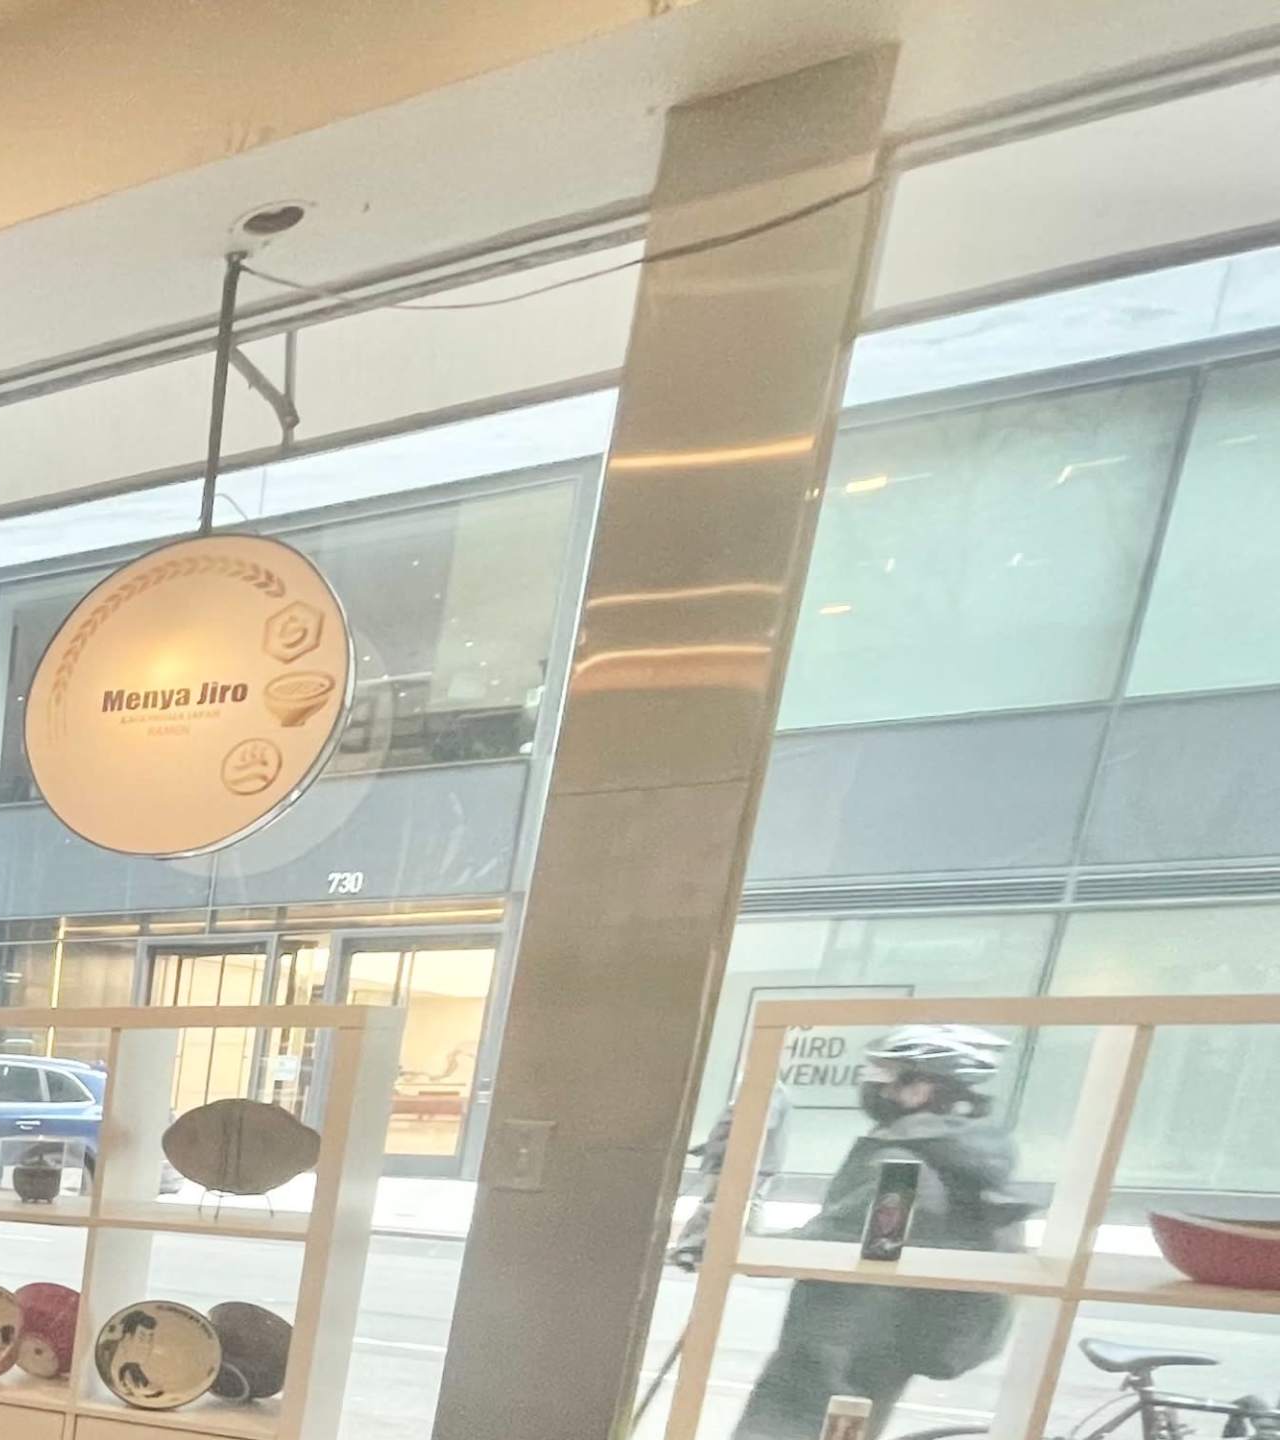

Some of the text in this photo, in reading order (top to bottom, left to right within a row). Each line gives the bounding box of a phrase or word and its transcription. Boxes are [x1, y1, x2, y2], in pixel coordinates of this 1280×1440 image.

[101, 681, 249, 712] Menya Jiro
[327, 871, 363, 895] 730
[784, 1036, 845, 1059] HIRD
[780, 1063, 867, 1087] VENUE
